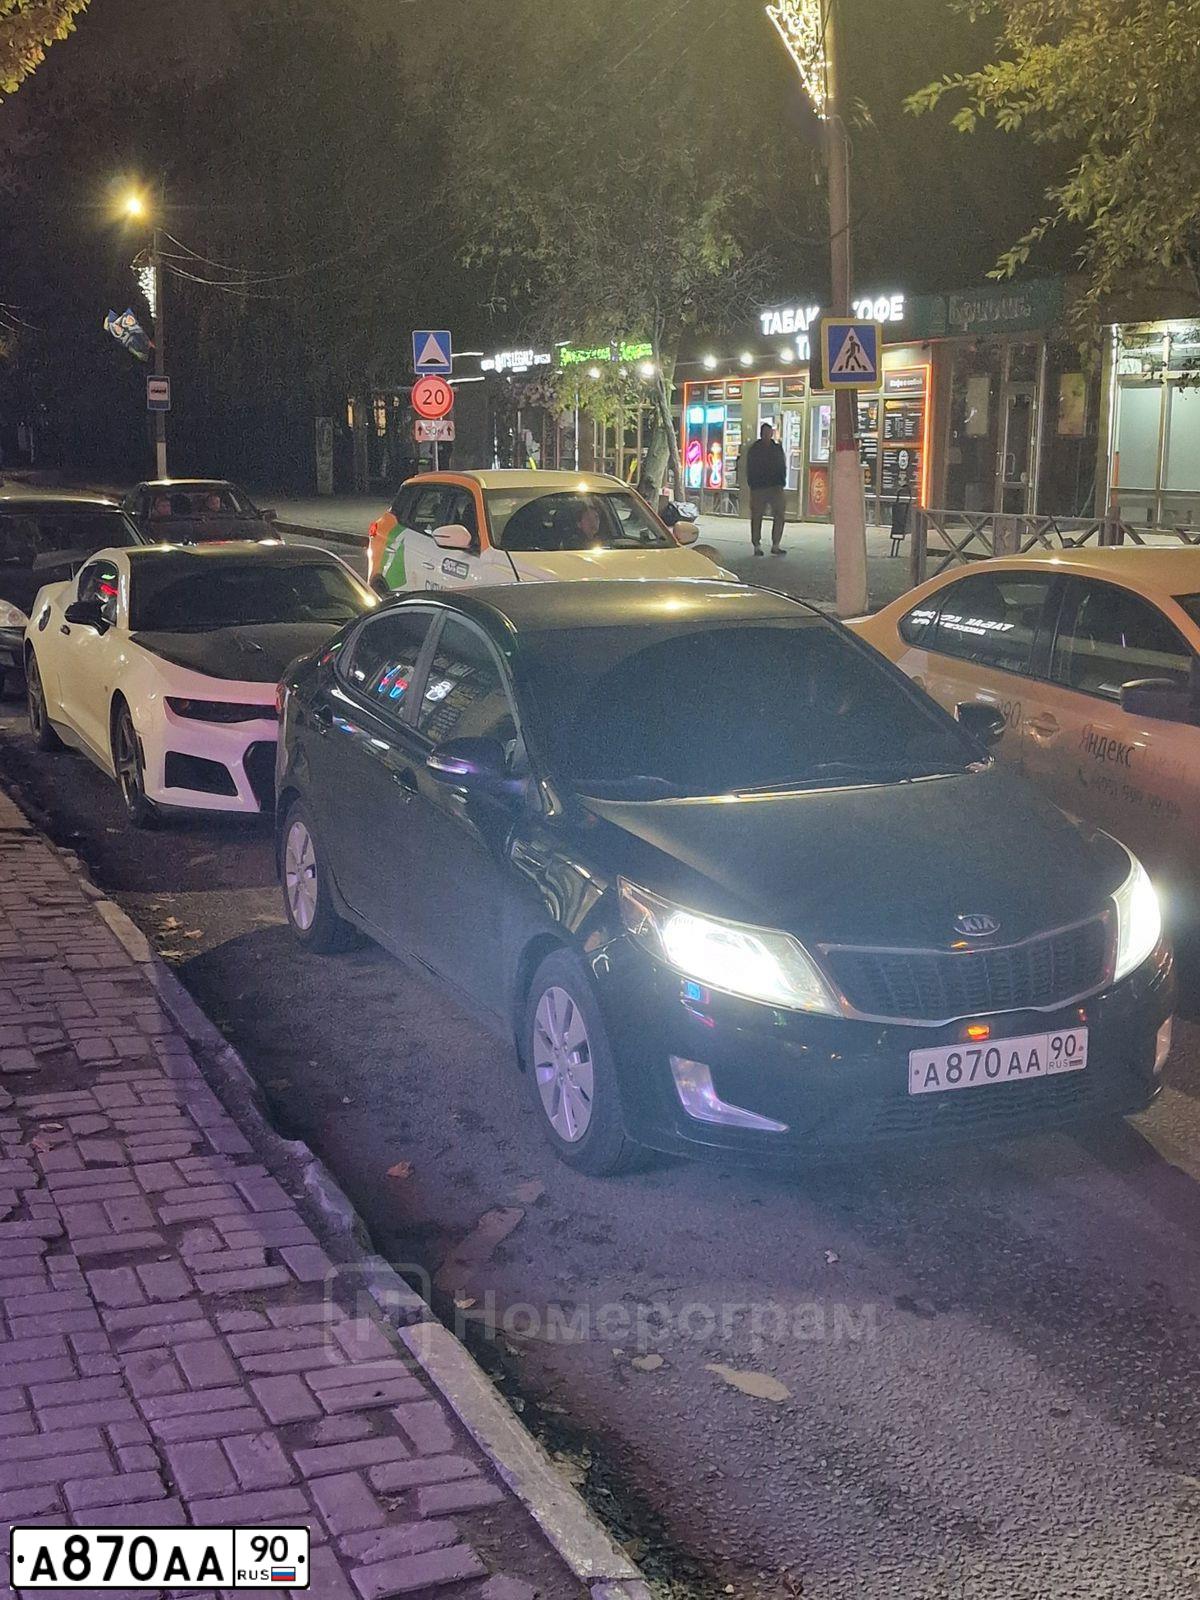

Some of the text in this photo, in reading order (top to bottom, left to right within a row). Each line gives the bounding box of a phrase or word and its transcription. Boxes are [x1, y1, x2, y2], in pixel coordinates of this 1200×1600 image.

[760, 295, 904, 335] ТАБАК ОФЕ
[422, 389, 445, 405] 20
[1079, 723, 1135, 768] Яндекс
[962, 917, 996, 932] KIA
[923, 1034, 1077, 1088] А870АА 90
[1049, 1060, 1069, 1070] RUS
